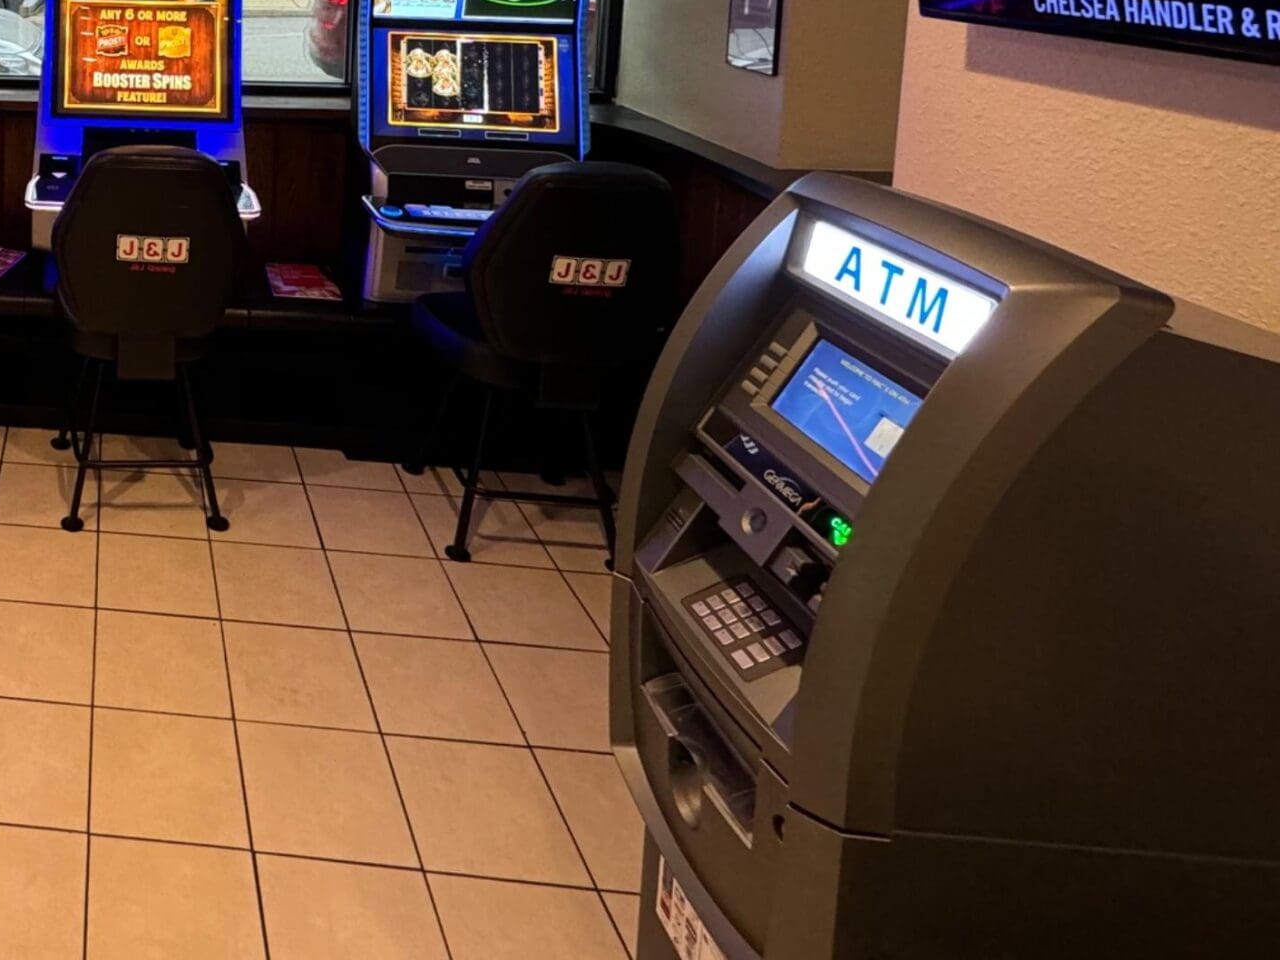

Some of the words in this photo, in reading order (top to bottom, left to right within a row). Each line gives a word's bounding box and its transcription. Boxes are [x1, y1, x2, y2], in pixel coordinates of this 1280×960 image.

[100, 8, 122, 20] ANY
[124, 8, 135, 20] 6
[137, 10, 153, 21] OR
[155, 10, 188, 22] MORE
[1241, 7, 1262, 38] &
[135, 36, 151, 46] OR
[120, 58, 165, 71] AWARDS
[93, 71, 151, 90] BOOSTER
[152, 72, 192, 91] SPINS
[117, 91, 167, 103] FEATURE!
[120, 239, 185, 260] J&J
[554, 259, 626, 284] J&J
[835, 246, 949, 334] ATM
